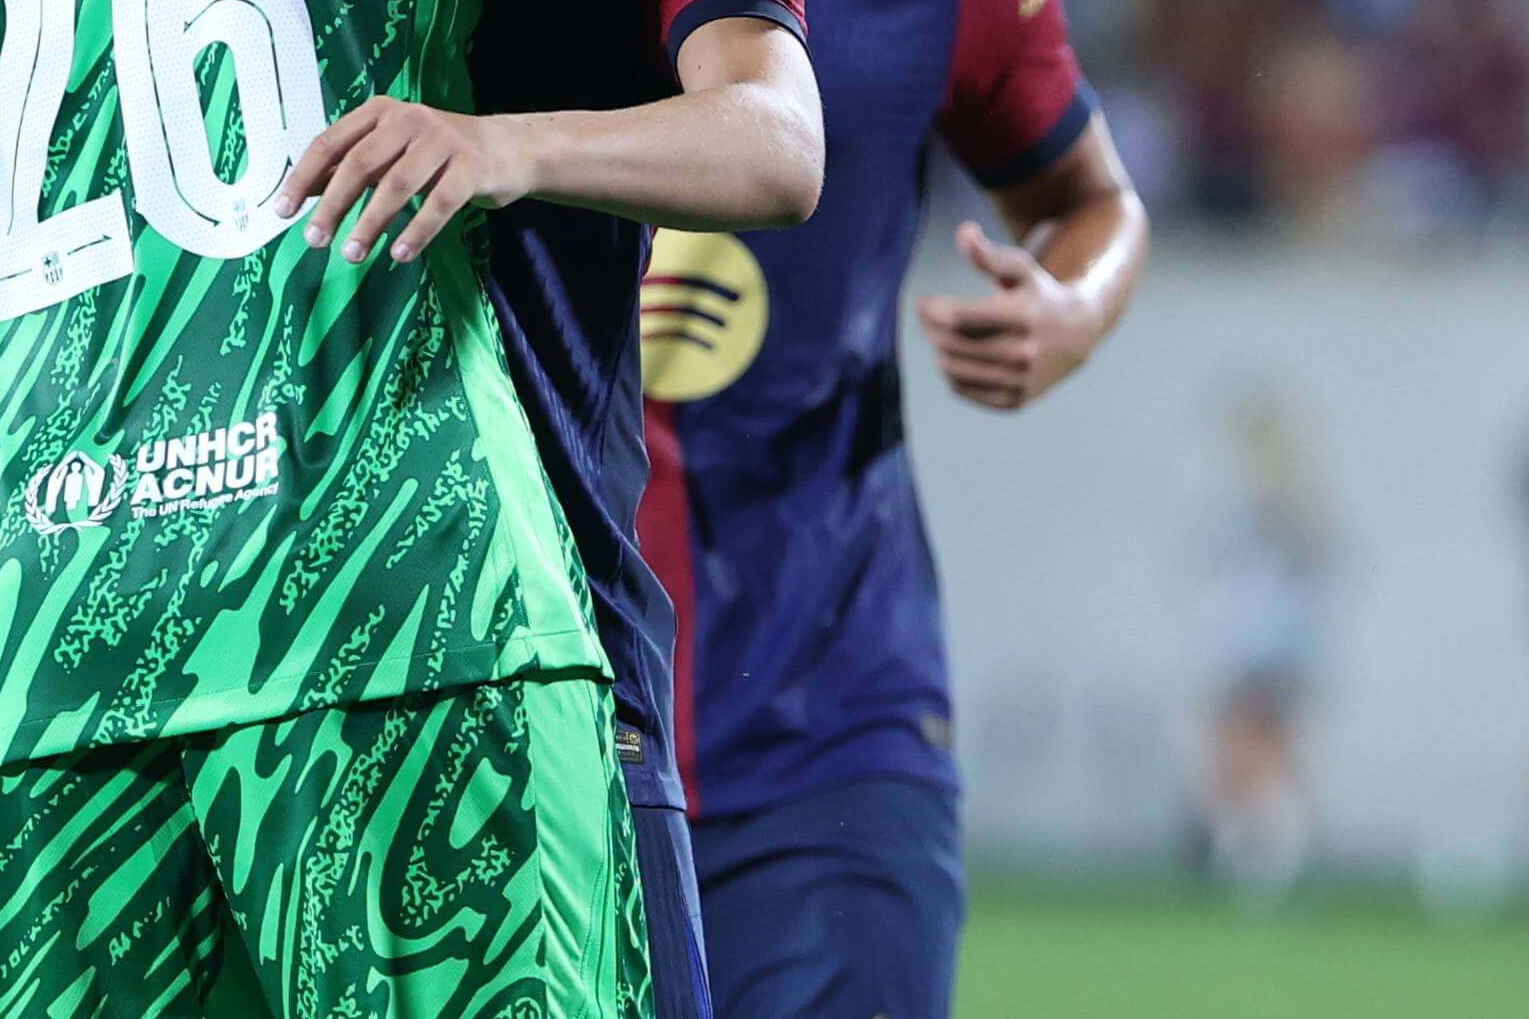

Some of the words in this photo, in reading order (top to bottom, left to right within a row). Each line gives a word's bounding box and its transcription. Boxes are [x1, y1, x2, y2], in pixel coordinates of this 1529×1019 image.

[136, 412, 278, 473] UNHCR
[130, 447, 279, 505] ACNUR
[132, 506, 157, 519] The
[158, 500, 178, 517] UN
[180, 492, 233, 511] Refugee
[234, 482, 280, 501] Agency
